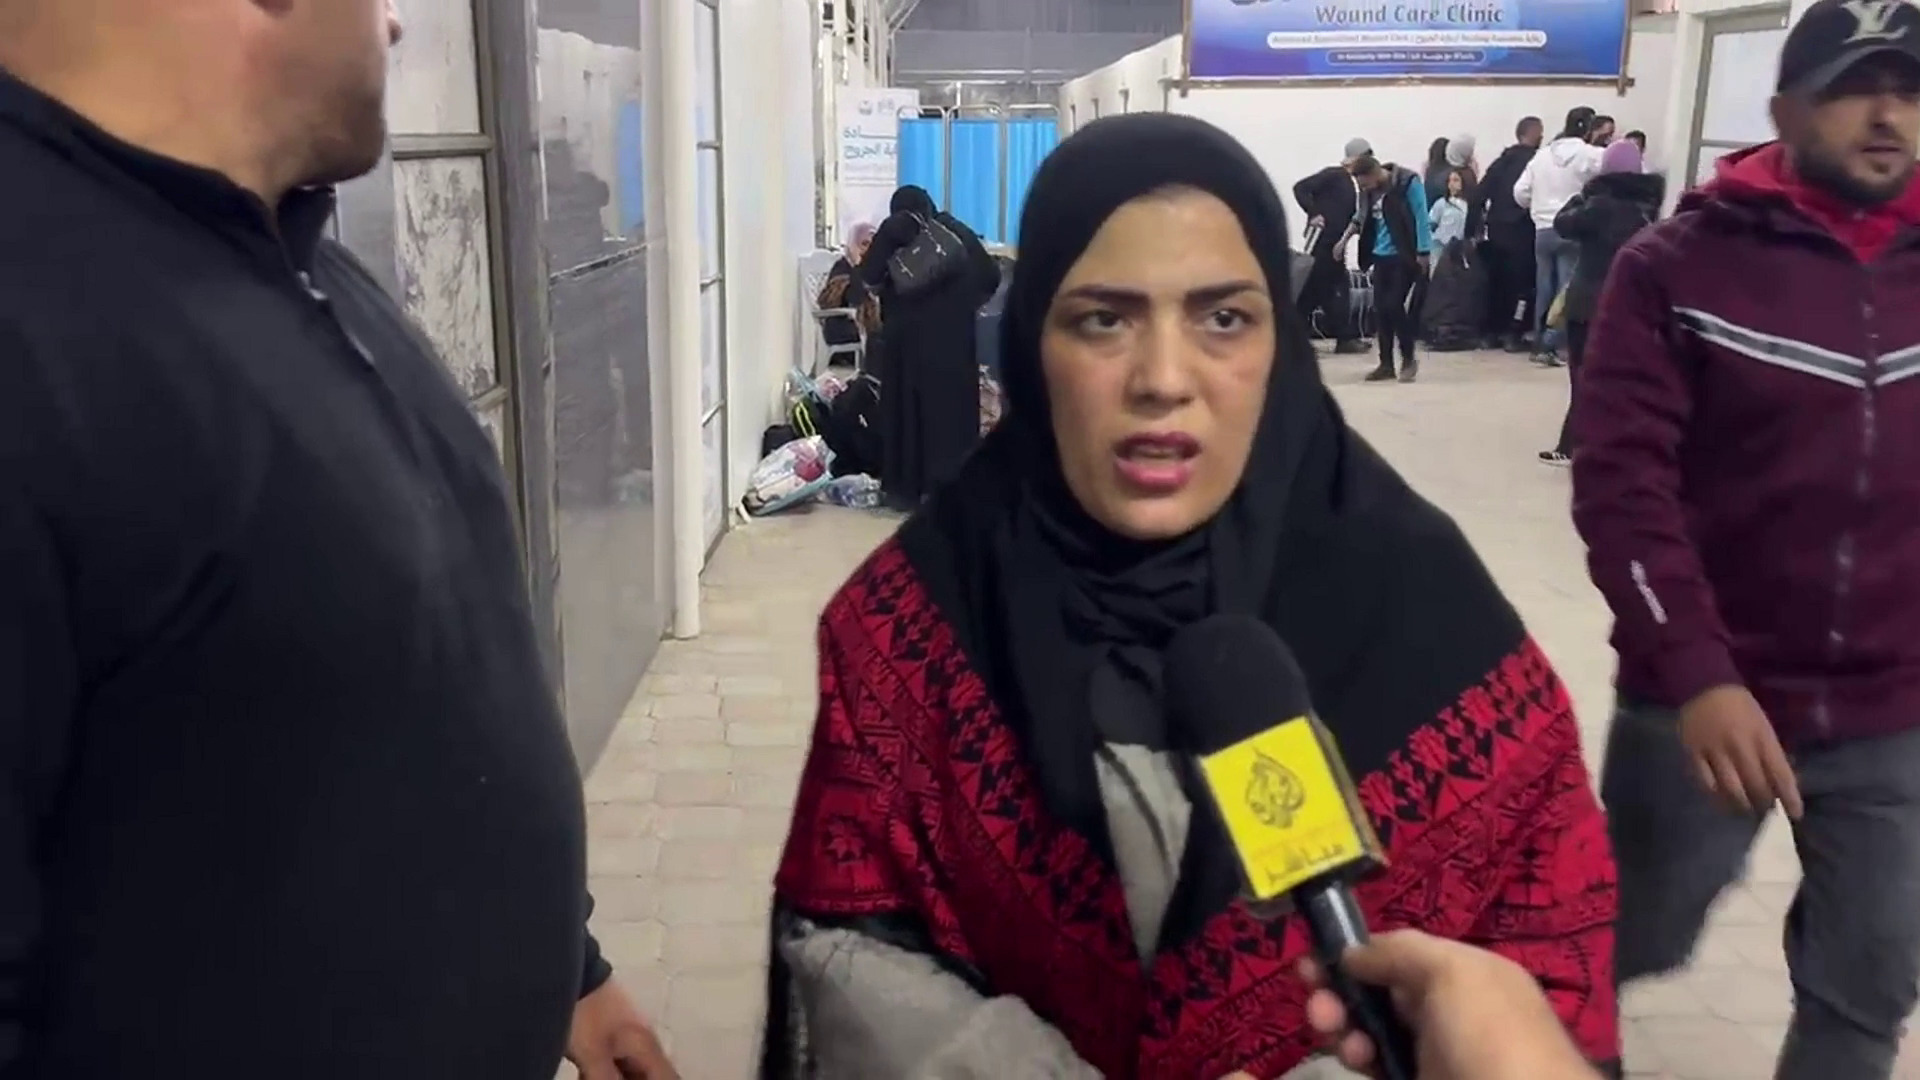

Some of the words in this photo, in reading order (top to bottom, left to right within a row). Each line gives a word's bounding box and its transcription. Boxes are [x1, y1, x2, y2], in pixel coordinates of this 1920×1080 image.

[1315, 5, 1387, 24] Wound
[1394, 5, 1440, 23] Care
[1446, 2, 1506, 23] Clinic
